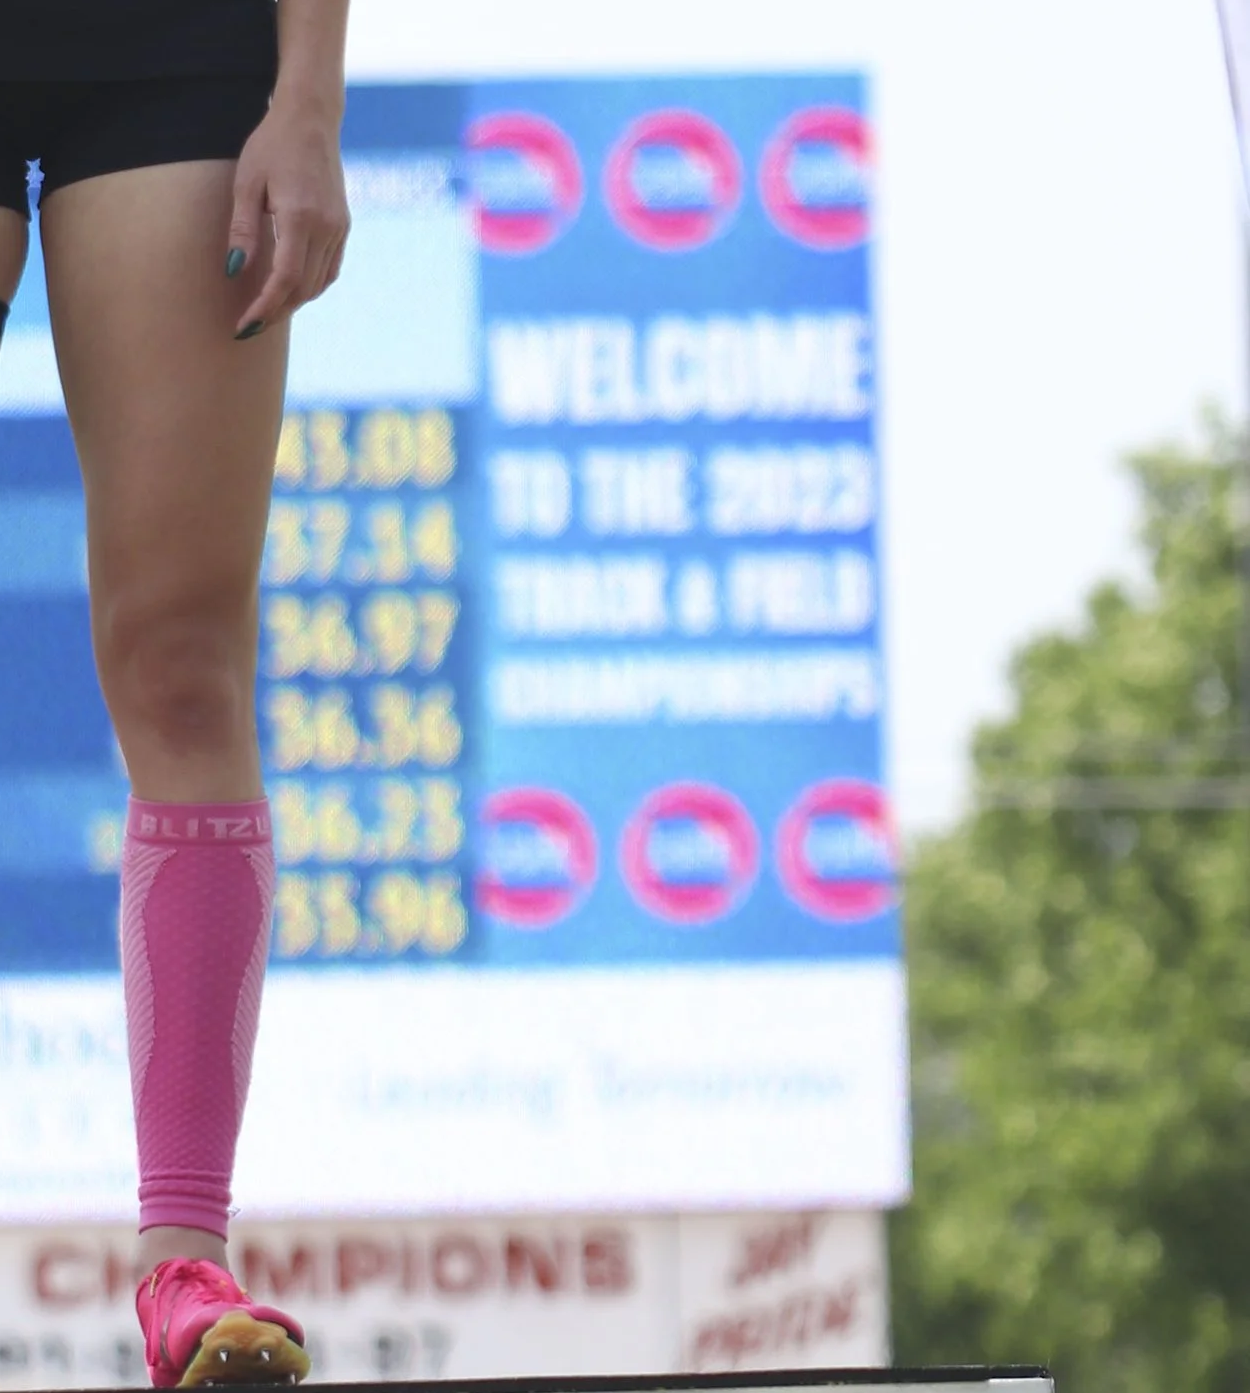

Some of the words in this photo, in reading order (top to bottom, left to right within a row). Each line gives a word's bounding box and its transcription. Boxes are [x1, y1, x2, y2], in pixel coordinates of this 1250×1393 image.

[488, 313, 873, 423] WELCOME
[490, 449, 570, 535] TO
[578, 449, 691, 534] THE
[34, 1227, 635, 1304] CHMPIONS
